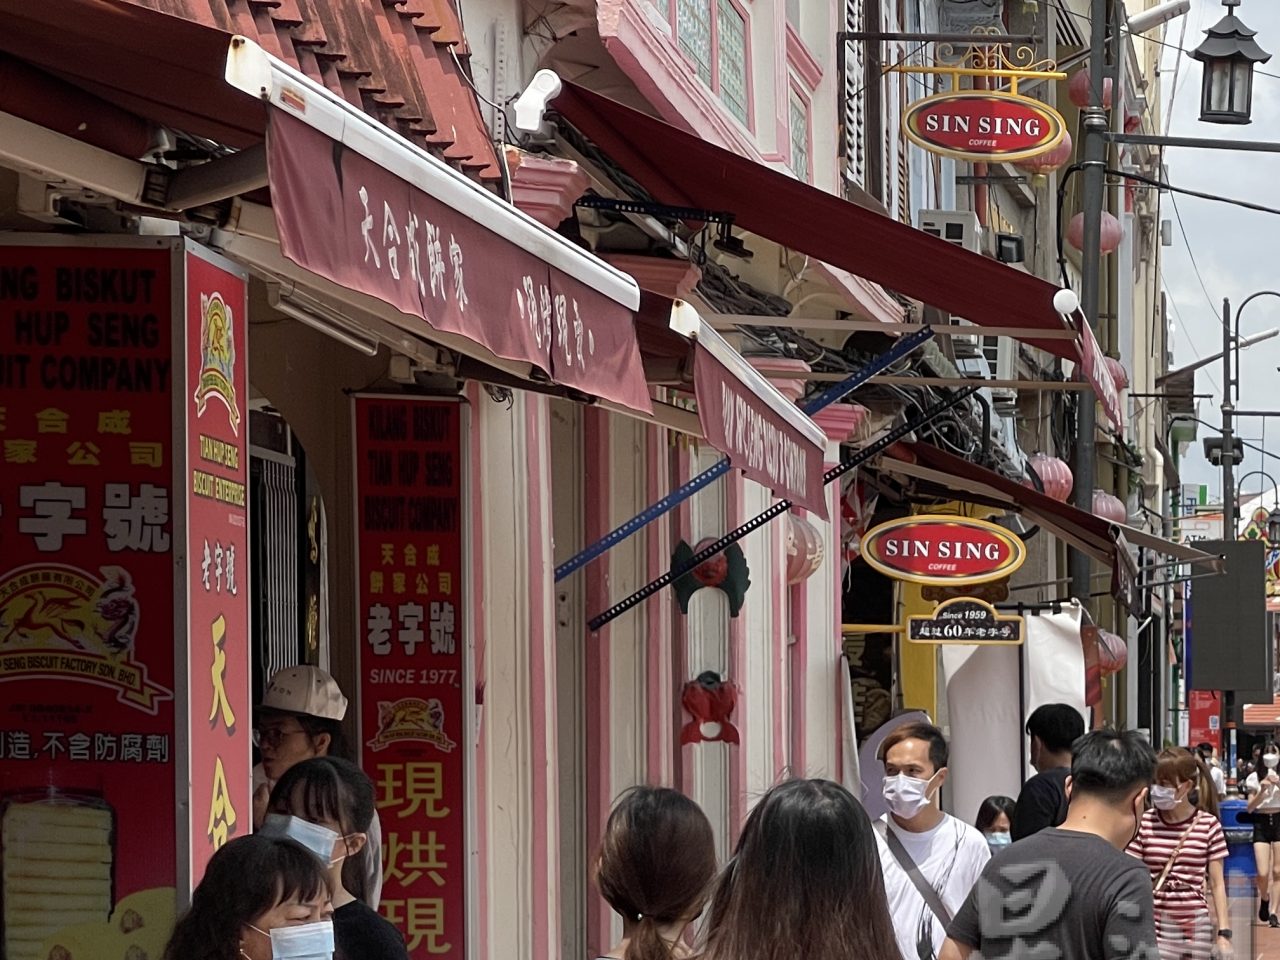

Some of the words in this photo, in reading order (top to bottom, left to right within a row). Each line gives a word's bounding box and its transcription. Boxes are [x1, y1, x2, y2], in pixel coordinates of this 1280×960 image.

[926, 114, 970, 133] SIN
[978, 117, 1040, 136] SING
[968, 138, 997, 147] COFFEE
[56, 267, 156, 304] BISKUT
[14, 310, 70, 346] HUP
[87, 312, 160, 349] SENG
[41, 355, 171, 393] COMPANY
[193, 470, 214, 496] BISCUIT
[381, 543, 440, 566] 天合成
[885, 540, 929, 557] SIN
[938, 542, 1000, 560] SING
[928, 563, 957, 571] COFFEE
[942, 611, 963, 619] Since
[964, 610, 987, 619] 1959
[367, 602, 455, 655] 老字號
[3, 655, 26, 671] SENG
[27, 655, 60, 669] BISCUIT
[60, 658, 97, 675] FACTORY
[369, 669, 416, 685] SINCE
[419, 669, 457, 685] 1977
